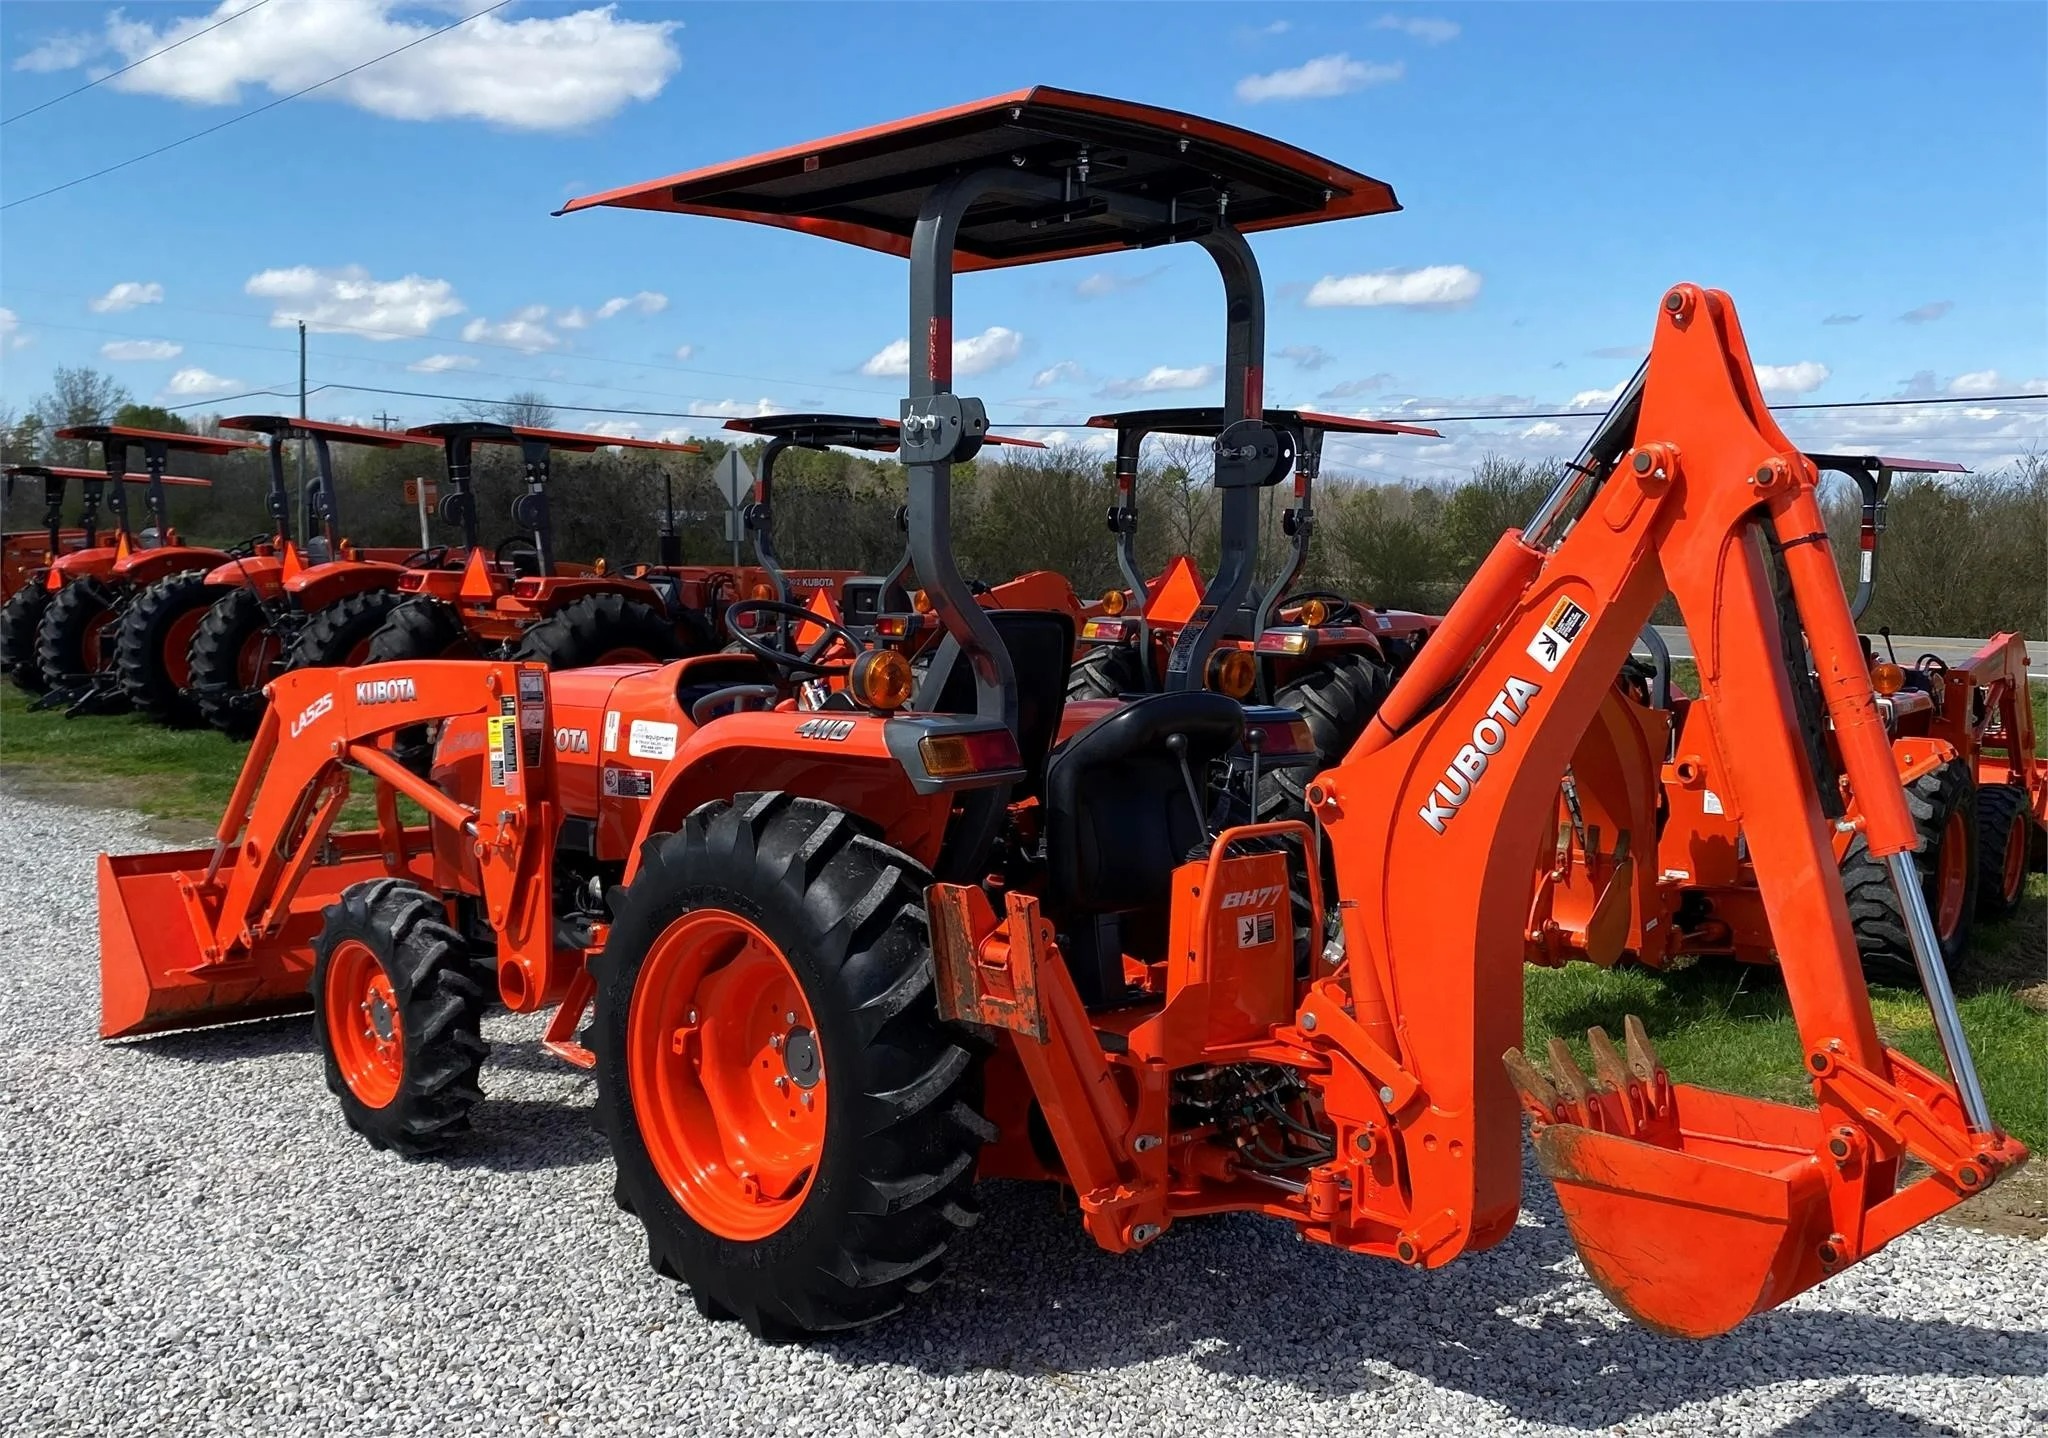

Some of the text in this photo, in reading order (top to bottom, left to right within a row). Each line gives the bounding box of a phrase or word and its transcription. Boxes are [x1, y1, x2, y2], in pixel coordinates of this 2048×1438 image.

[802, 577, 834, 587] KUBOTA
[355, 677, 417, 706] KUBOTA
[290, 692, 333, 738] LA525
[553, 727, 590, 754] OTA
[794, 718, 857, 742] 4WD
[1418, 675, 1542, 835] KUBOTA
[1220, 884, 1284, 910] BH77
